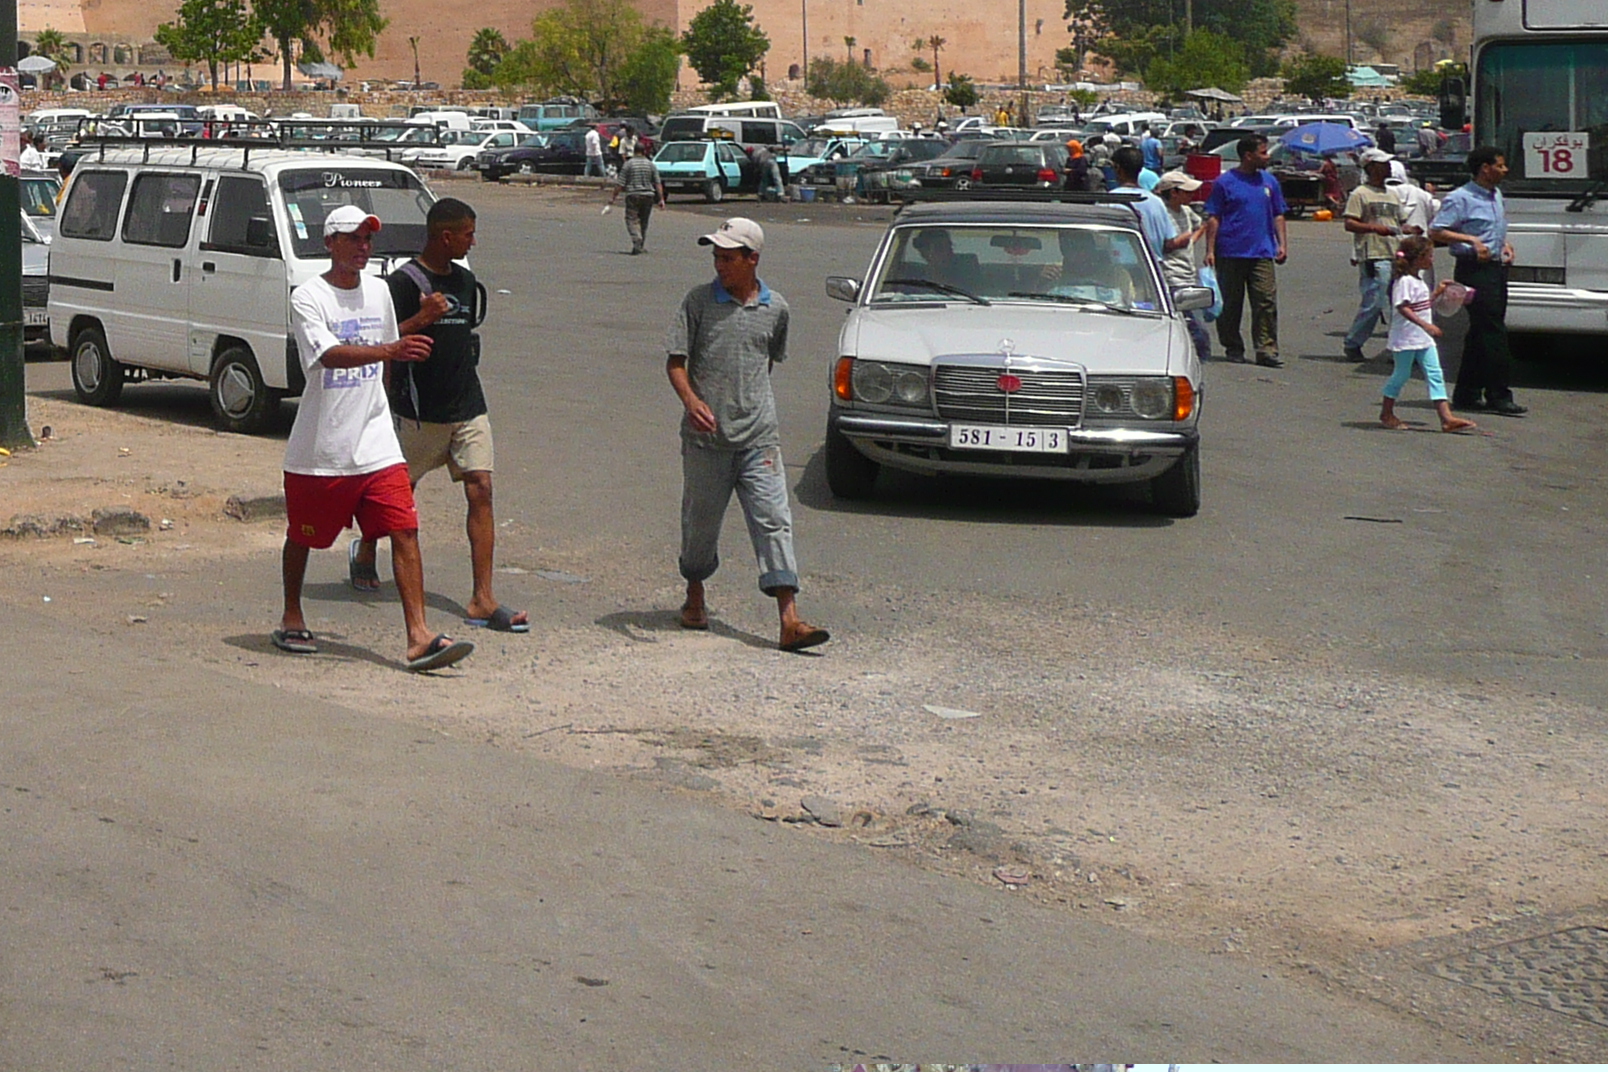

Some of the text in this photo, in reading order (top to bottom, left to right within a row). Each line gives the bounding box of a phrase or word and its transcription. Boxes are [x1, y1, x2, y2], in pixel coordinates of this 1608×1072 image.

[1537, 149, 1574, 173] 18
[321, 171, 383, 188] Pioneer
[332, 365, 379, 381] PRIX
[958, 429, 991, 446] 581
[1015, 431, 1036, 448] 15
[1048, 432, 1058, 449] 3
